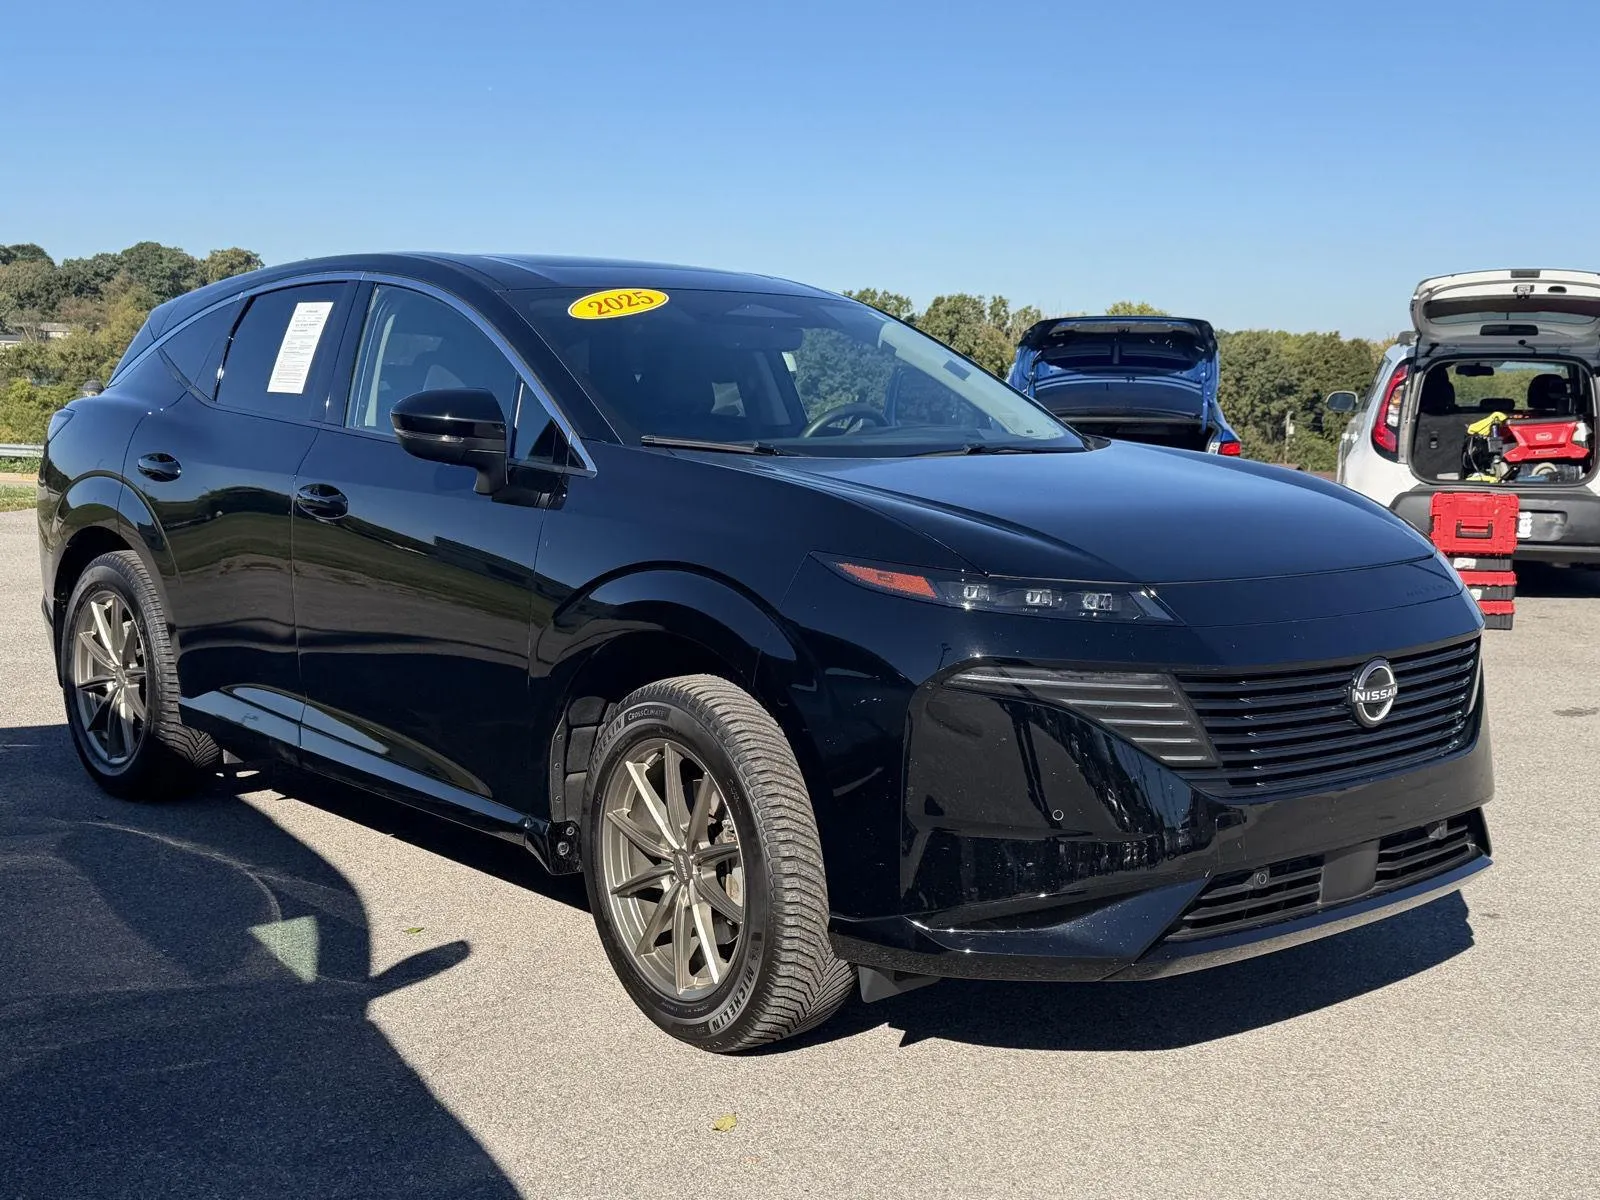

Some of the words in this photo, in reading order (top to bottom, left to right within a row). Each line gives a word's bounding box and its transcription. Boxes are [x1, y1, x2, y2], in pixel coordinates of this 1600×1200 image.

[588, 292, 654, 315] 2025
[1355, 686, 1397, 701] NISSAN
[712, 966, 755, 1031] MICHELIN
